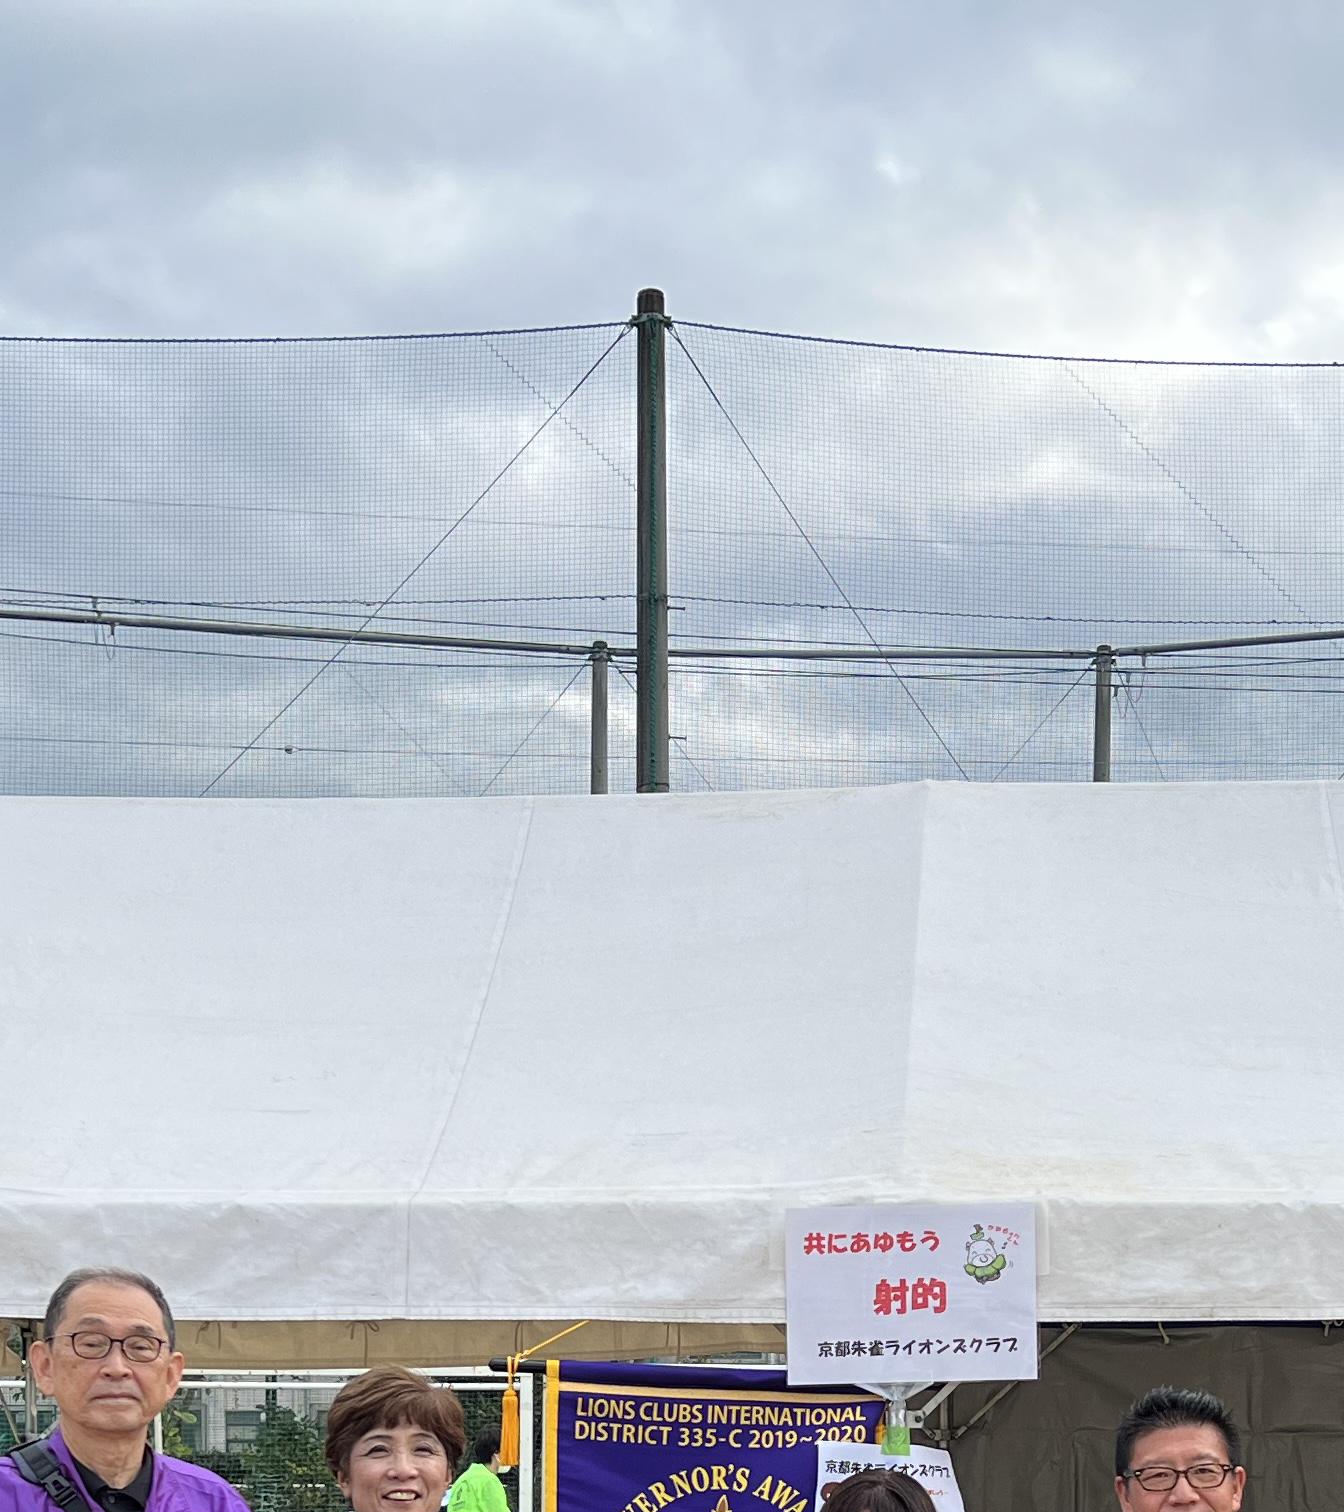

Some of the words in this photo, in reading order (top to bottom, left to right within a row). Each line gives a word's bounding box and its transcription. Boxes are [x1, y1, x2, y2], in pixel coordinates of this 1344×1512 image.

[803, 1230, 941, 1255] 共にあゆもう
[873, 1277, 948, 1316] 射的
[817, 1337, 1019, 1358] 京都朱雀ライオンズクラブ
[576, 1396, 636, 1420] LIONS
[639, 1400, 703, 1424] CLUBS
[707, 1404, 867, 1427] INTERNATIONAL
[574, 1420, 673, 1445] DISTRICT
[677, 1426, 743, 1448] 335-C
